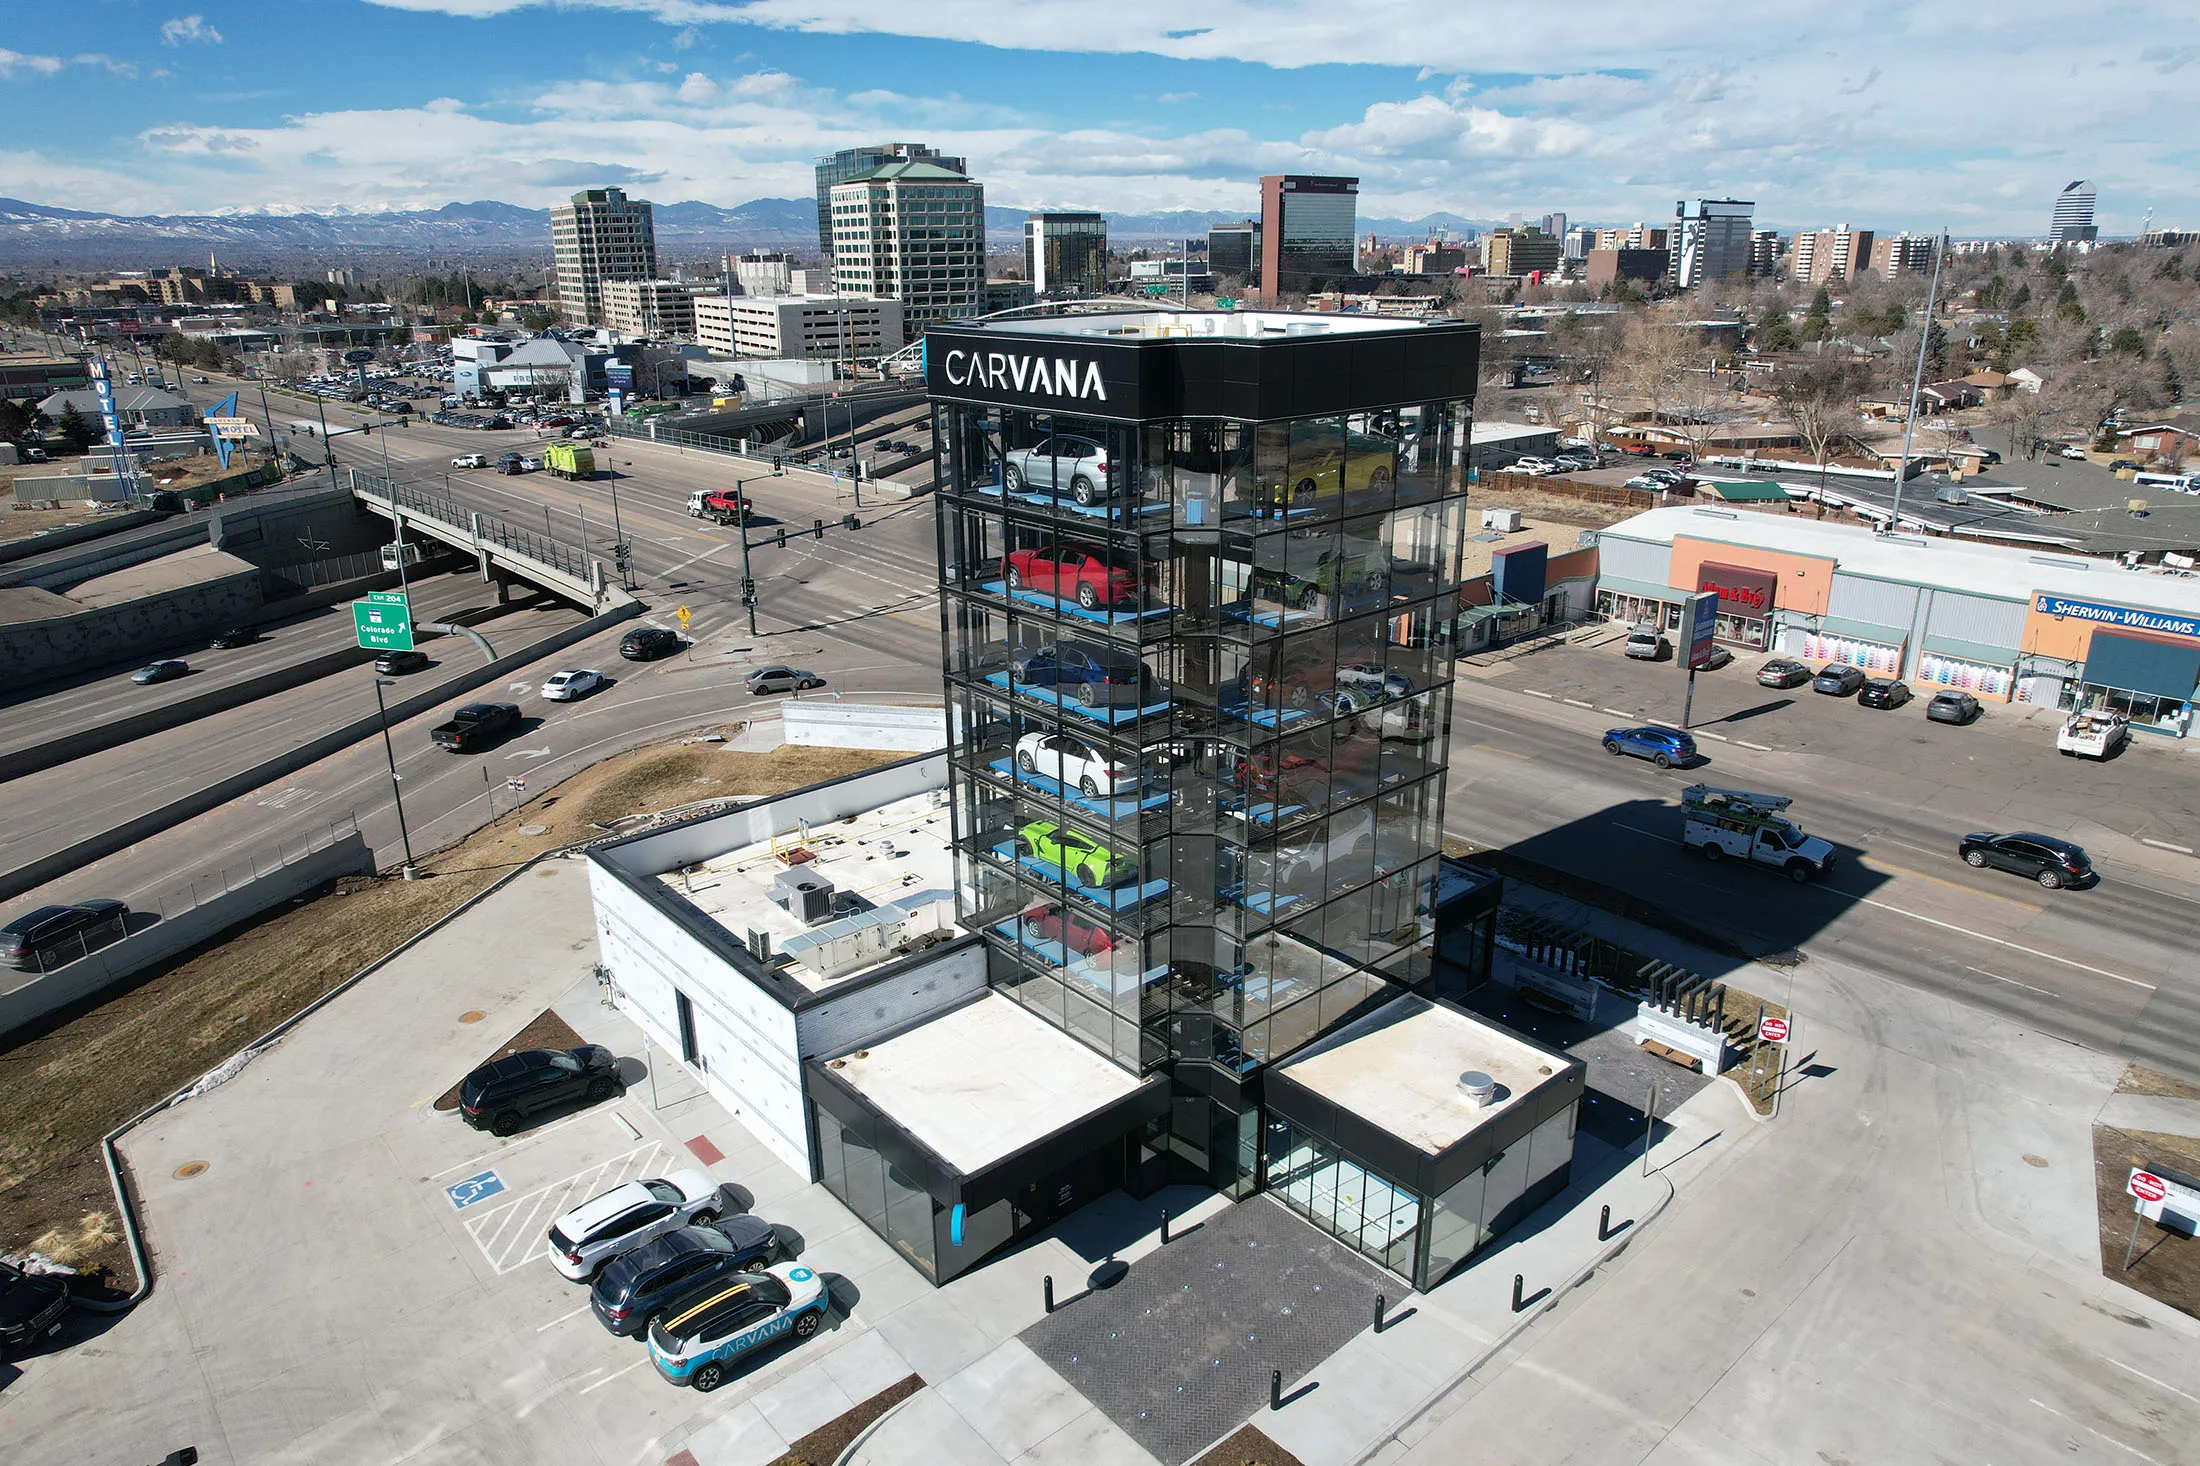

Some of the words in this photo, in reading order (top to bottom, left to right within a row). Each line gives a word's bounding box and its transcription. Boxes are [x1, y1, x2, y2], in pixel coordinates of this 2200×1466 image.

[945, 350, 1107, 401] CARVANA
[88, 362, 120, 446] MOTEL
[221, 425, 255, 434] MOTEL
[1729, 586, 1740, 601] &
[1741, 587, 1765, 608] Eve
[2052, 600, 2195, 634] SHERWIN-WILLIAMS
[360, 624, 396, 635] Colorado
[370, 635, 389, 643] Blvd
[2136, 1174, 2147, 1183] DO
[2148, 1180, 2164, 1188] NOT
[2135, 1186, 2158, 1199] ENTER
[712, 1316, 793, 1361] CARVANA
